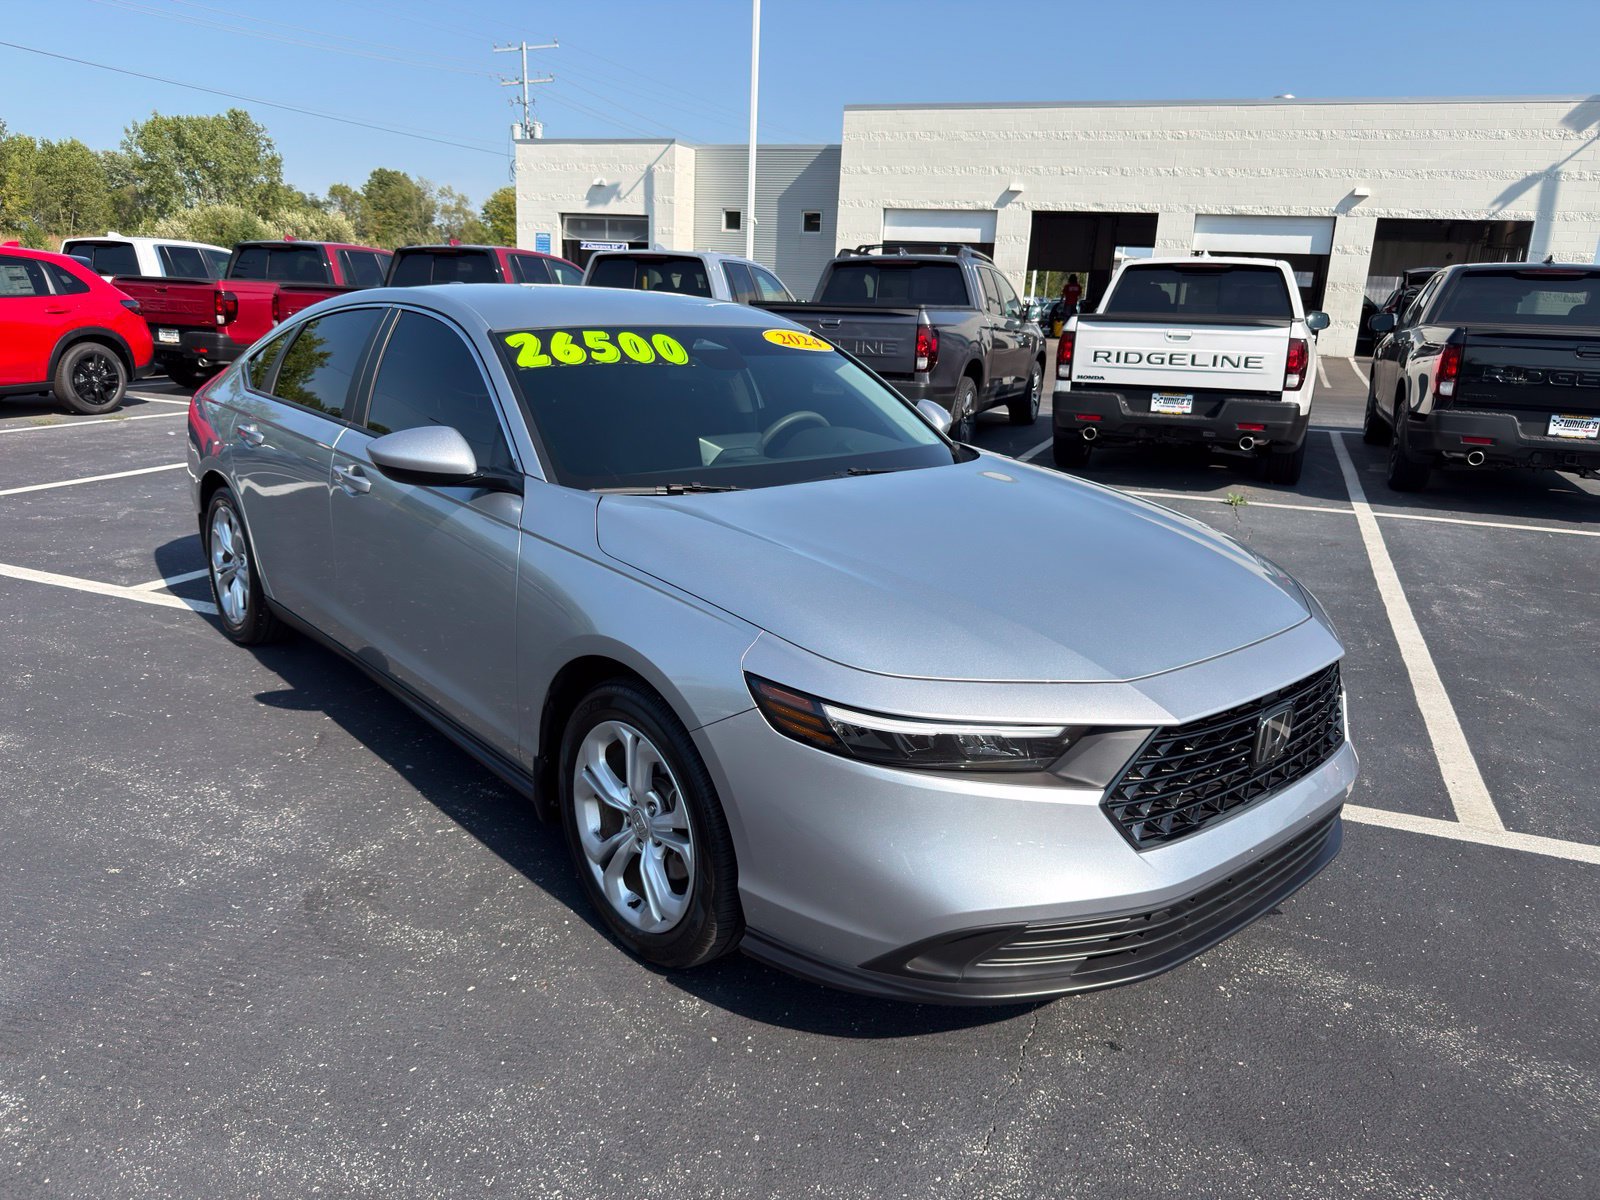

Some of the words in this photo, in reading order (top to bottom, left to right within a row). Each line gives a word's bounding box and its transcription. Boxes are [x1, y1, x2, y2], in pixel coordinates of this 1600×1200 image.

[505, 330, 689, 368] 26500
[776, 332, 822, 349] 2024
[1093, 350, 1265, 370] RIDGELINE
